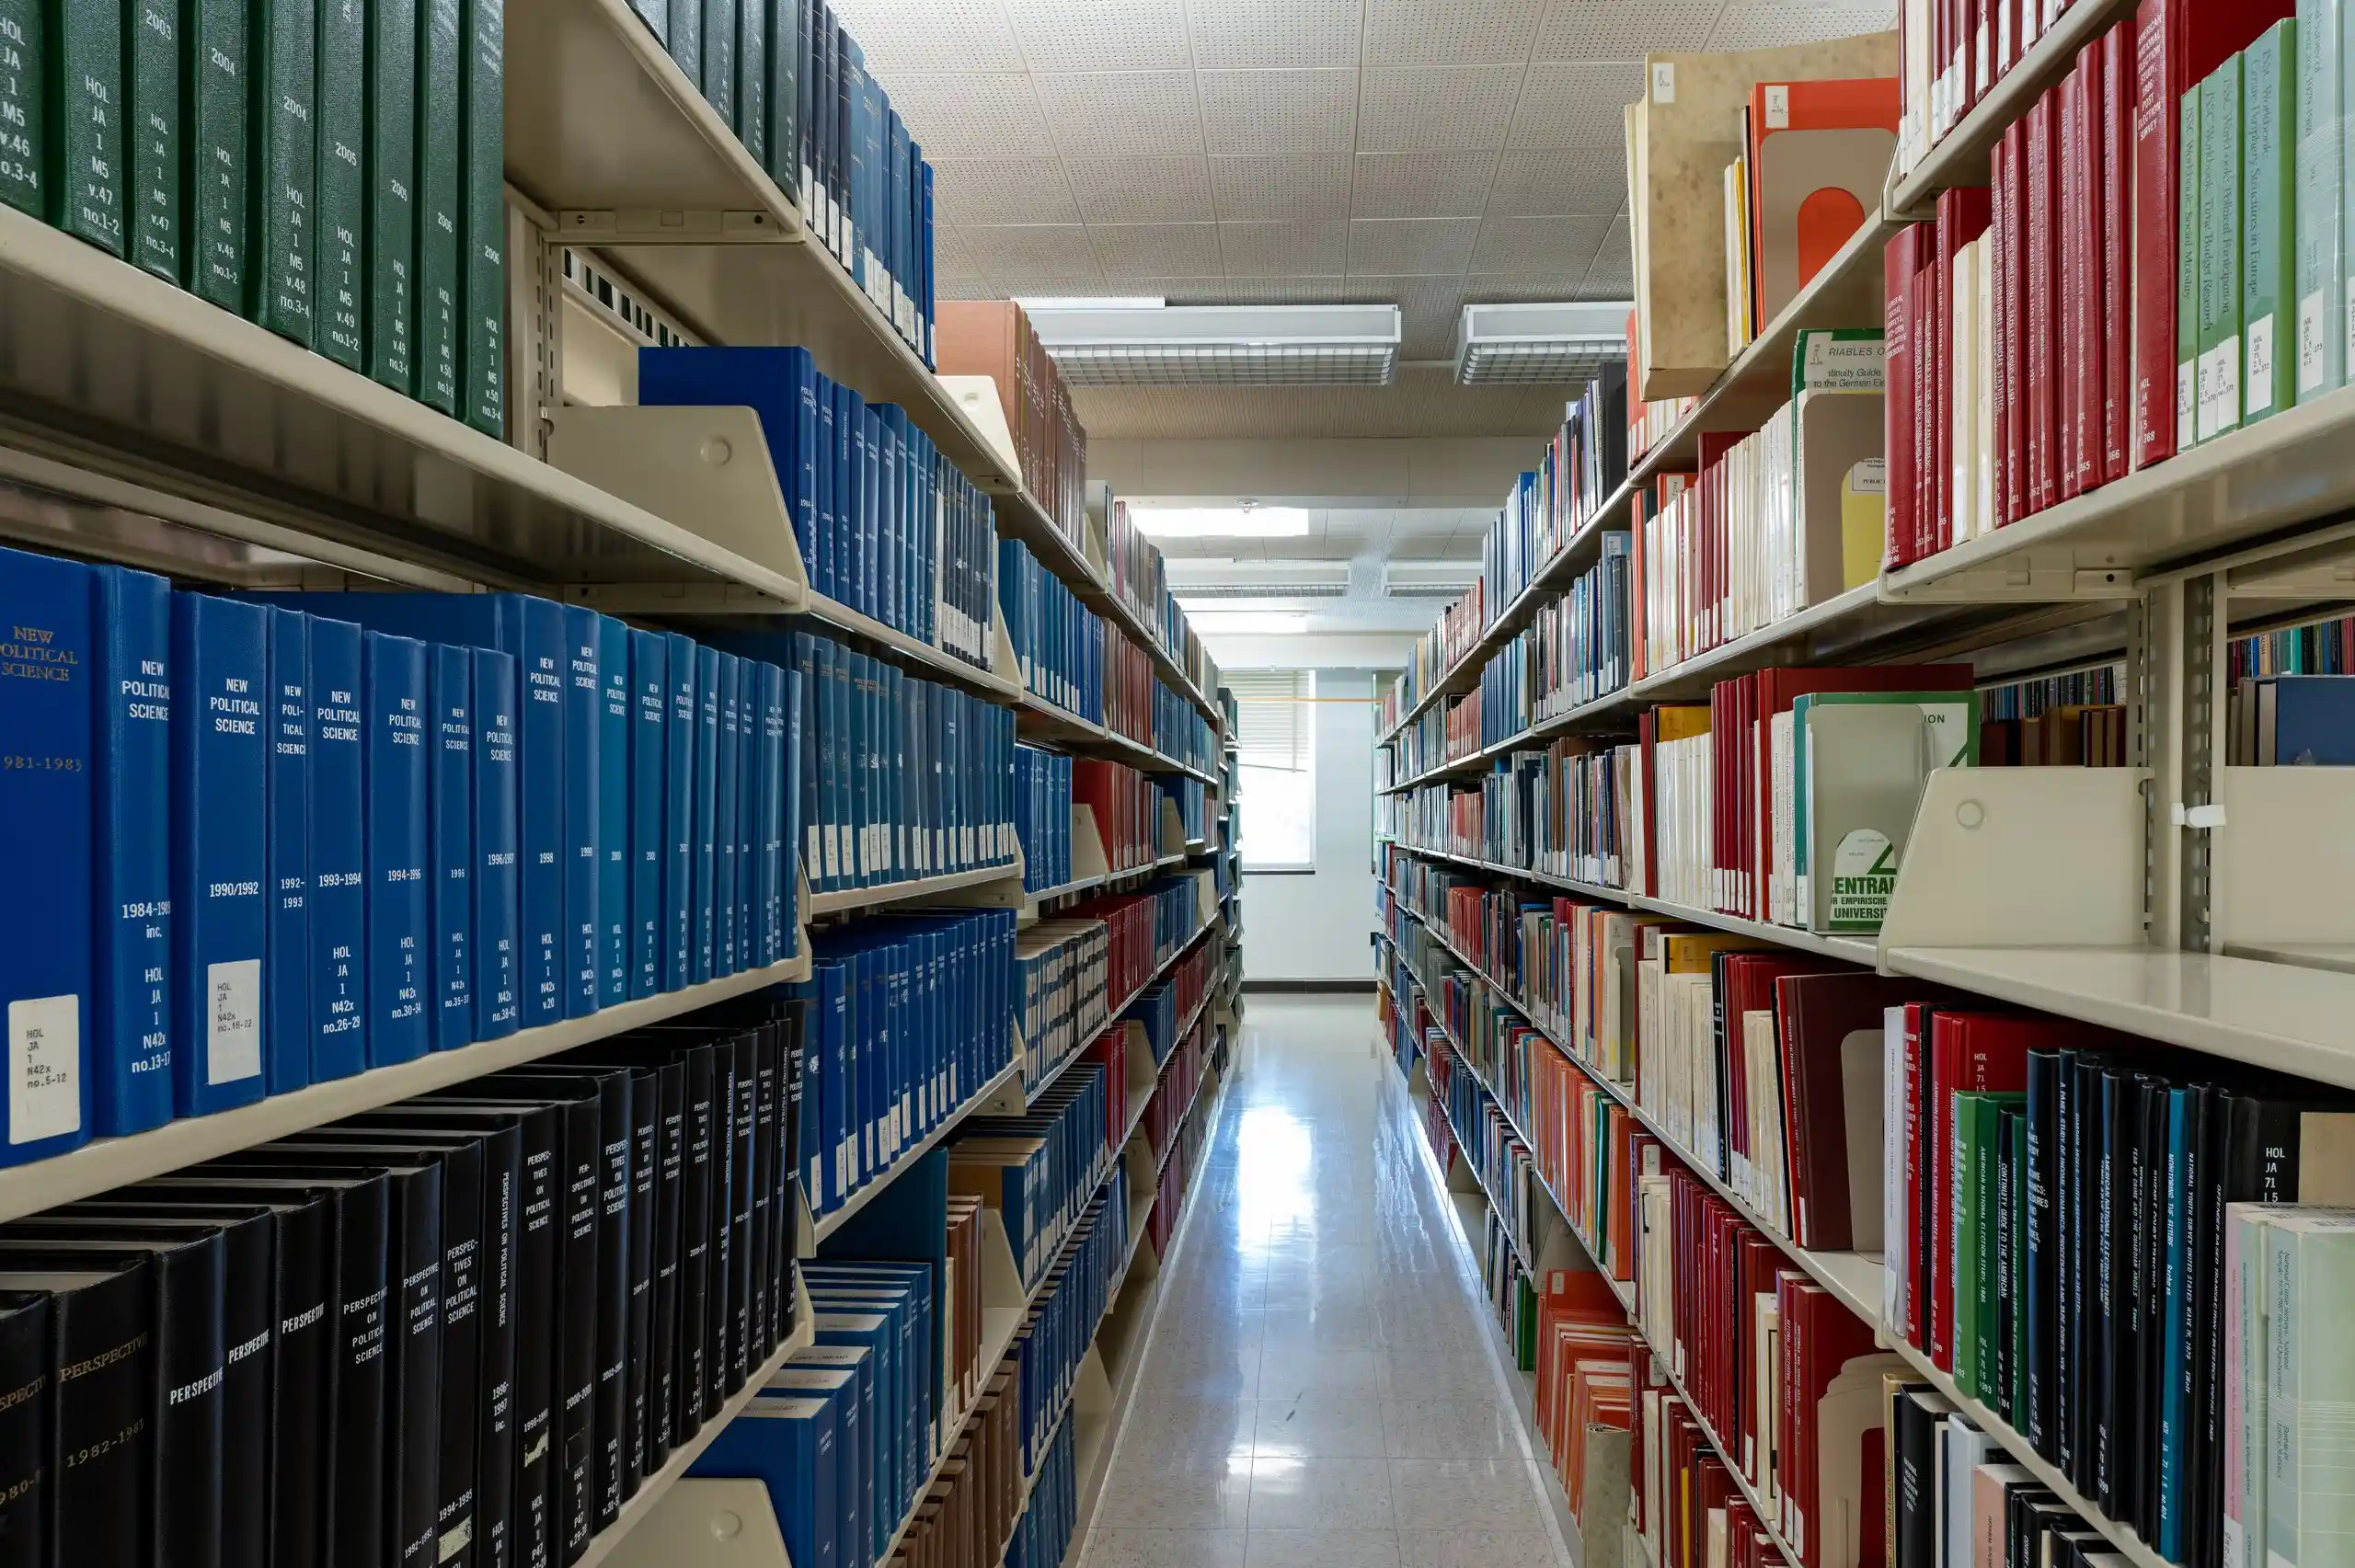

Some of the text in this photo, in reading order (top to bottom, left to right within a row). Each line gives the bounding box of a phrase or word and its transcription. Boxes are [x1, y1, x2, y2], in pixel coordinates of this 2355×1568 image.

[146, 10, 172, 40] 2003
[4, 47, 20, 70] JA
[212, 48, 236, 76] 2004
[86, 74, 109, 104] HOL
[2, 101, 25, 126] M5
[92, 107, 106, 127] JA
[283, 97, 307, 121] 2004
[151, 114, 167, 134] HOL
[2141, 120, 2157, 141] SURVEY
[155, 142, 165, 156] JA
[217, 147, 232, 166] HOL
[335, 142, 357, 166] 2005
[92, 156, 109, 178] M5
[89, 183, 113, 205] v.47
[154, 189, 167, 206] M5
[286, 184, 305, 209] HOL
[392, 179, 408, 202] 2005
[84, 207, 120, 235] no.1-2
[151, 214, 169, 231] v.47
[220, 218, 231, 235] M5
[291, 210, 302, 227] JA
[338, 225, 354, 247] HOL
[145, 235, 174, 258] no.3-4
[217, 241, 235, 259] v.48
[485, 246, 500, 265] 2006
[289, 253, 303, 271] M5
[213, 263, 238, 286] no.1-2
[286, 274, 305, 294] v.48
[281, 294, 309, 318] no.3-4
[340, 290, 352, 307] M5
[337, 310, 355, 327] v.49
[332, 328, 359, 352] no.1-2
[1857, 368, 1881, 377] Guide
[1839, 379, 1870, 387] German
[13, 626, 53, 645] NEW
[1, 662, 70, 681] SCIENCE
[142, 660, 165, 677] NEW
[226, 678, 248, 693] NEW
[531, 672, 560, 687] POLITICAL
[284, 685, 302, 697] NEW
[331, 691, 350, 704] NEW
[534, 689, 558, 703] SCIENCE
[129, 703, 169, 721] SCIENCE
[210, 697, 260, 715] POLITICAL
[401, 698, 416, 711] NEW
[317, 707, 361, 724] POLITICAL
[389, 714, 422, 729] POLITICAL
[215, 718, 256, 736] SCIENCE
[283, 724, 304, 736] TICAL
[323, 727, 358, 741] SCIENCE
[393, 732, 419, 746] SCIENCE
[319, 872, 362, 887] 1993-1994
[210, 881, 258, 898] 1990/1992
[283, 897, 303, 909] 1993
[400, 936, 414, 948] HOL
[333, 946, 351, 959] HOL
[145, 967, 164, 982] HOL
[338, 965, 348, 977] JA
[151, 990, 161, 1003] JA
[332, 1001, 354, 1014] N42x
[323, 1015, 361, 1034] no.26-29
[144, 1034, 167, 1049] N42x
[132, 1051, 171, 1073] no.13-17
[1974, 1053, 1987, 1061] HOL
[2266, 1147, 2286, 1159] HOL
[533, 1167, 547, 1180] TIVES
[2265, 1162, 2278, 1173] JA
[2265, 1177, 2276, 1188] 71
[525, 1197, 551, 1216] POLITICAL
[528, 1214, 549, 1231] SCIENCE
[447, 1239, 478, 1261] PERSPEC-
[454, 1256, 472, 1274] TIVES
[457, 1274, 467, 1288] ON
[445, 1285, 477, 1310] POLITICAL
[367, 1311, 377, 1323] ON
[410, 1298, 436, 1319] POLITICAL
[447, 1302, 475, 1324] SCIENCE
[412, 1314, 433, 1334] SCIENCE
[355, 1343, 384, 1364] SCIENCE
